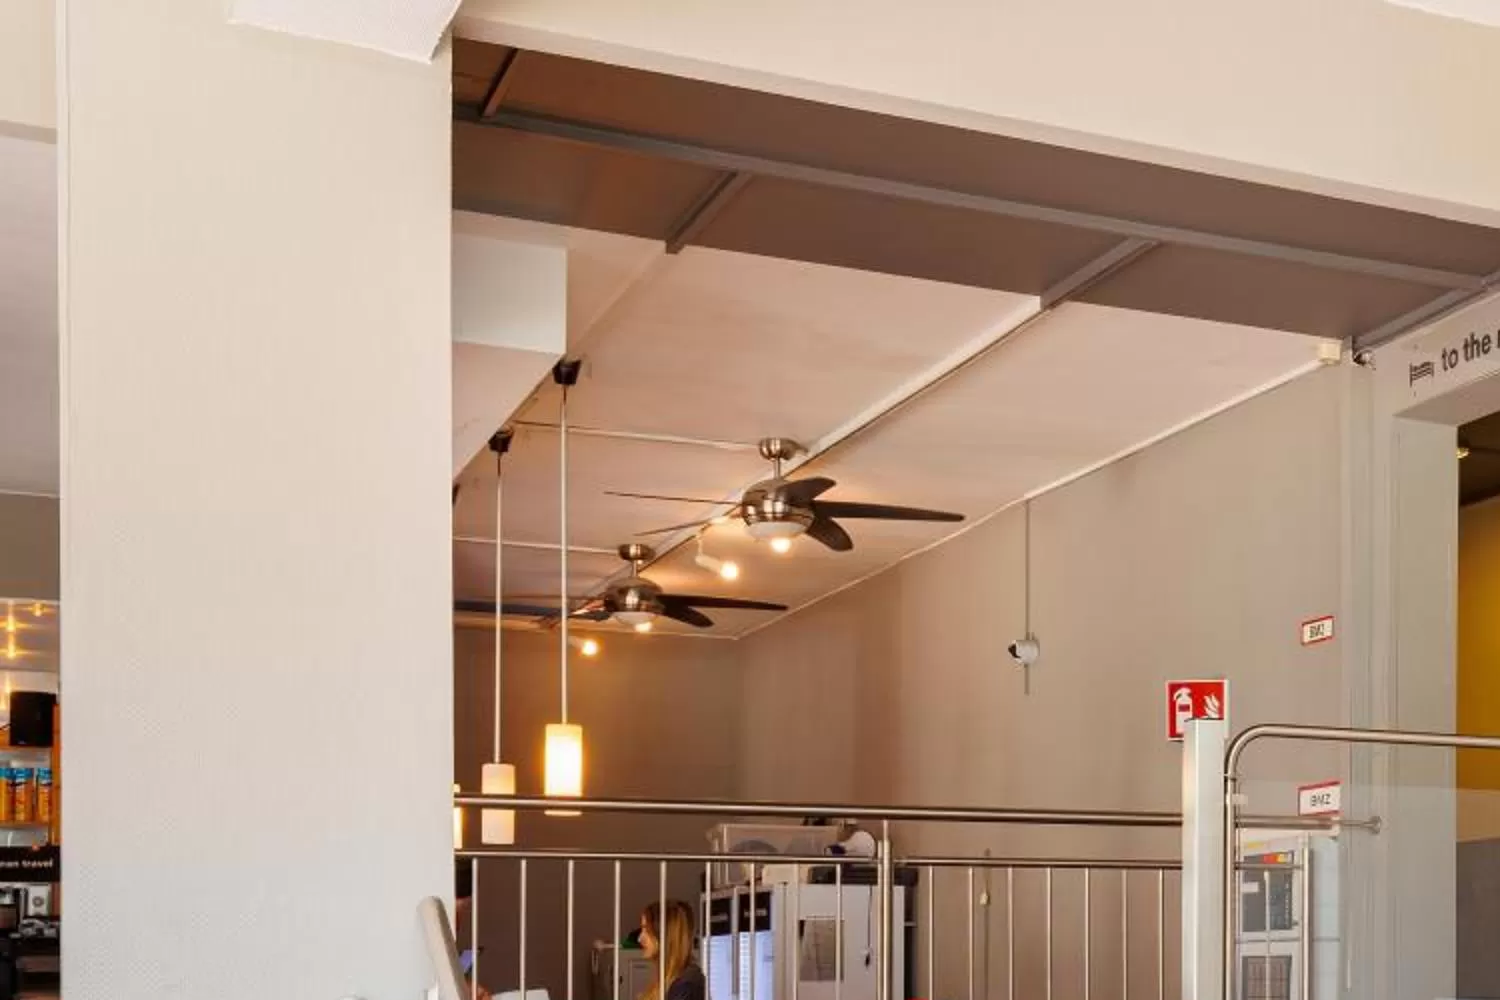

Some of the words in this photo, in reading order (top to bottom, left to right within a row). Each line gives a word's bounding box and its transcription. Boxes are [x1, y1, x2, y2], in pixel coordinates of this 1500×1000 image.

[1441, 347, 1459, 372] to
[1462, 332, 1492, 363] the
[21, 857, 54, 869] travel
